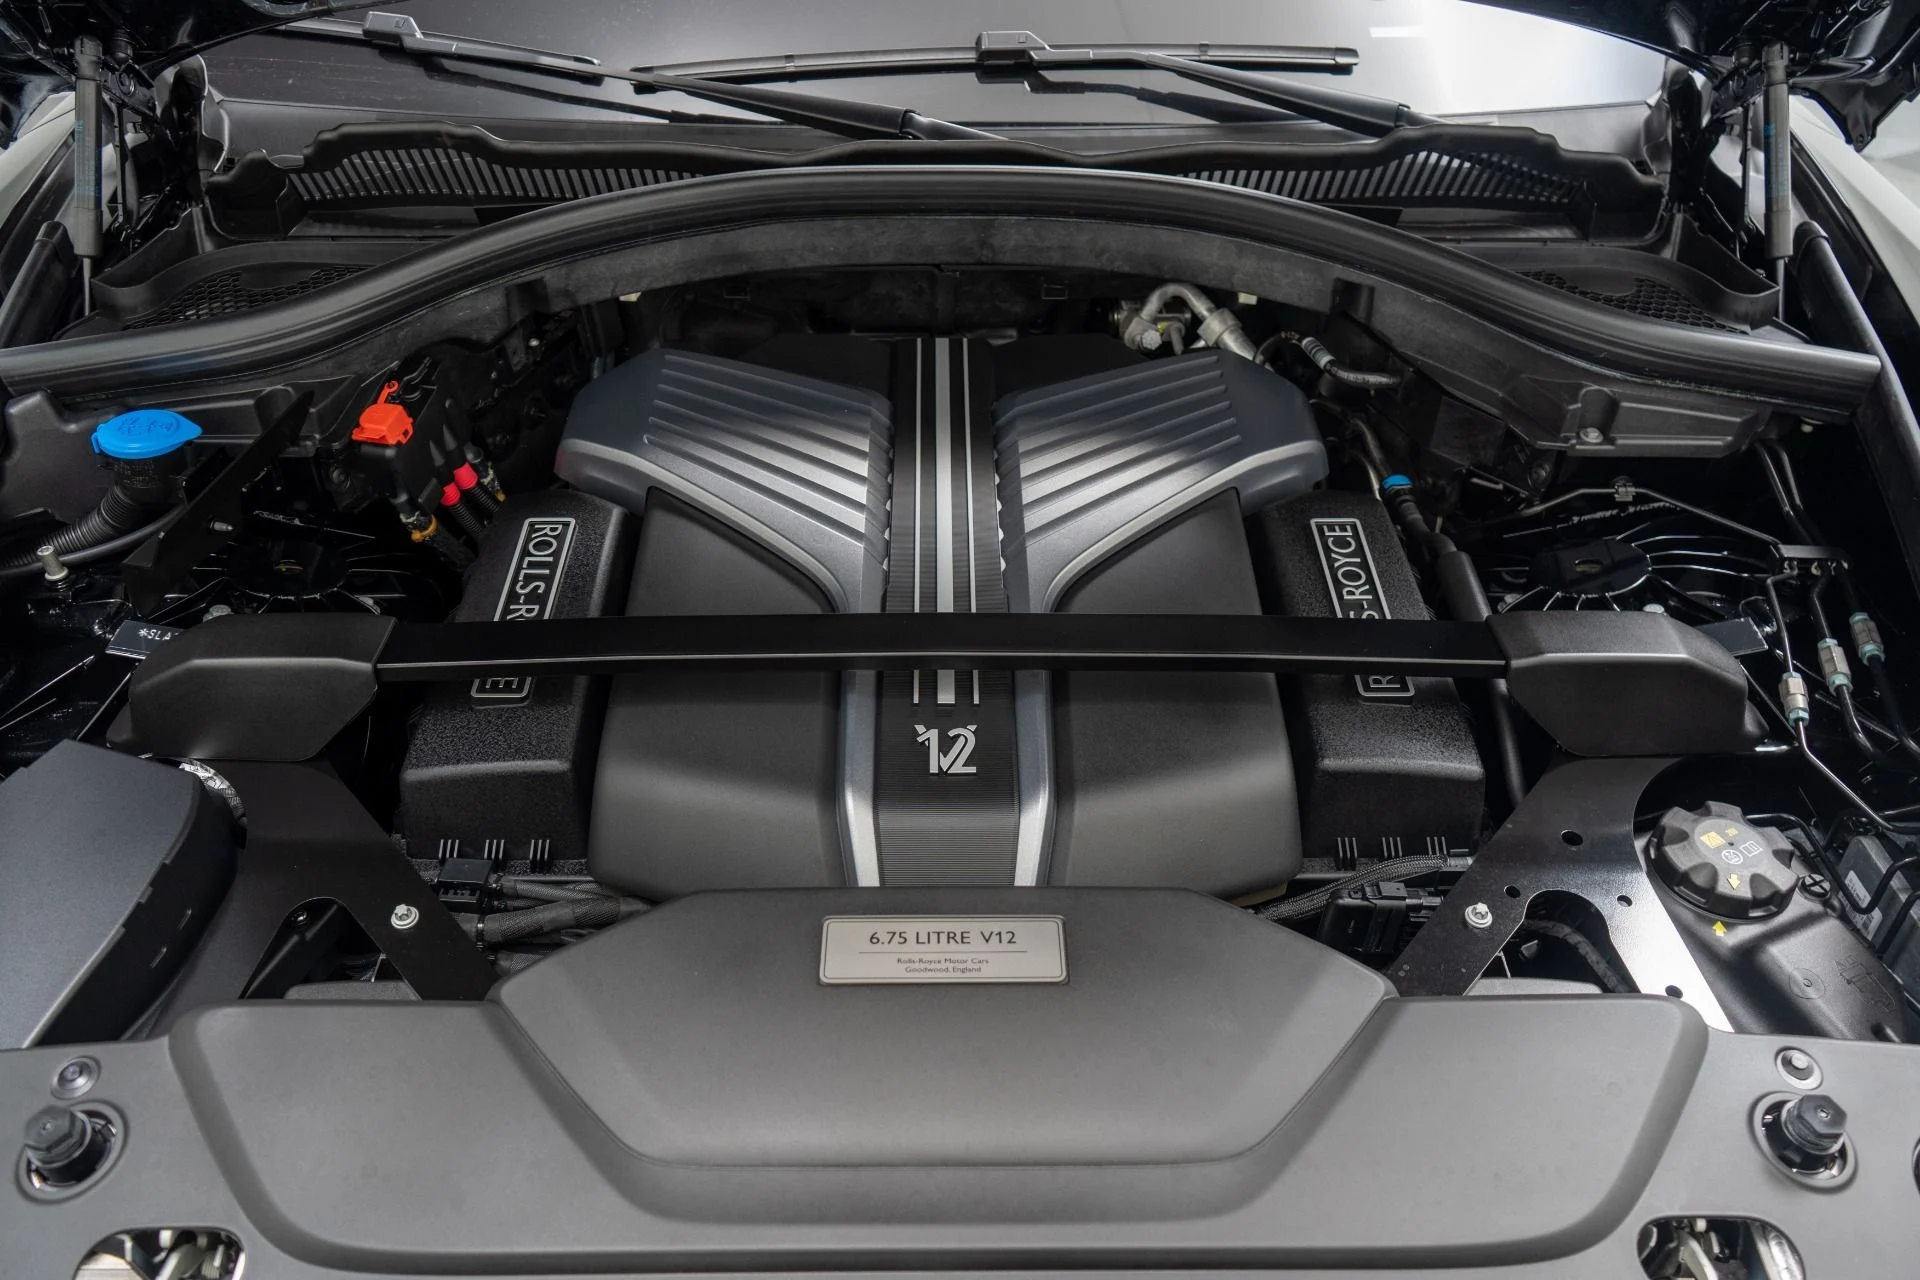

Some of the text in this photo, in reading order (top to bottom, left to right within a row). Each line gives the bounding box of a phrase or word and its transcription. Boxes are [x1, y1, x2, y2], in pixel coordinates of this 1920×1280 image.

[869, 930, 1017, 945] 6.75 LITRE V12
[897, 957, 942, 965] Rolls-Royce
[952, 966, 982, 974] England
